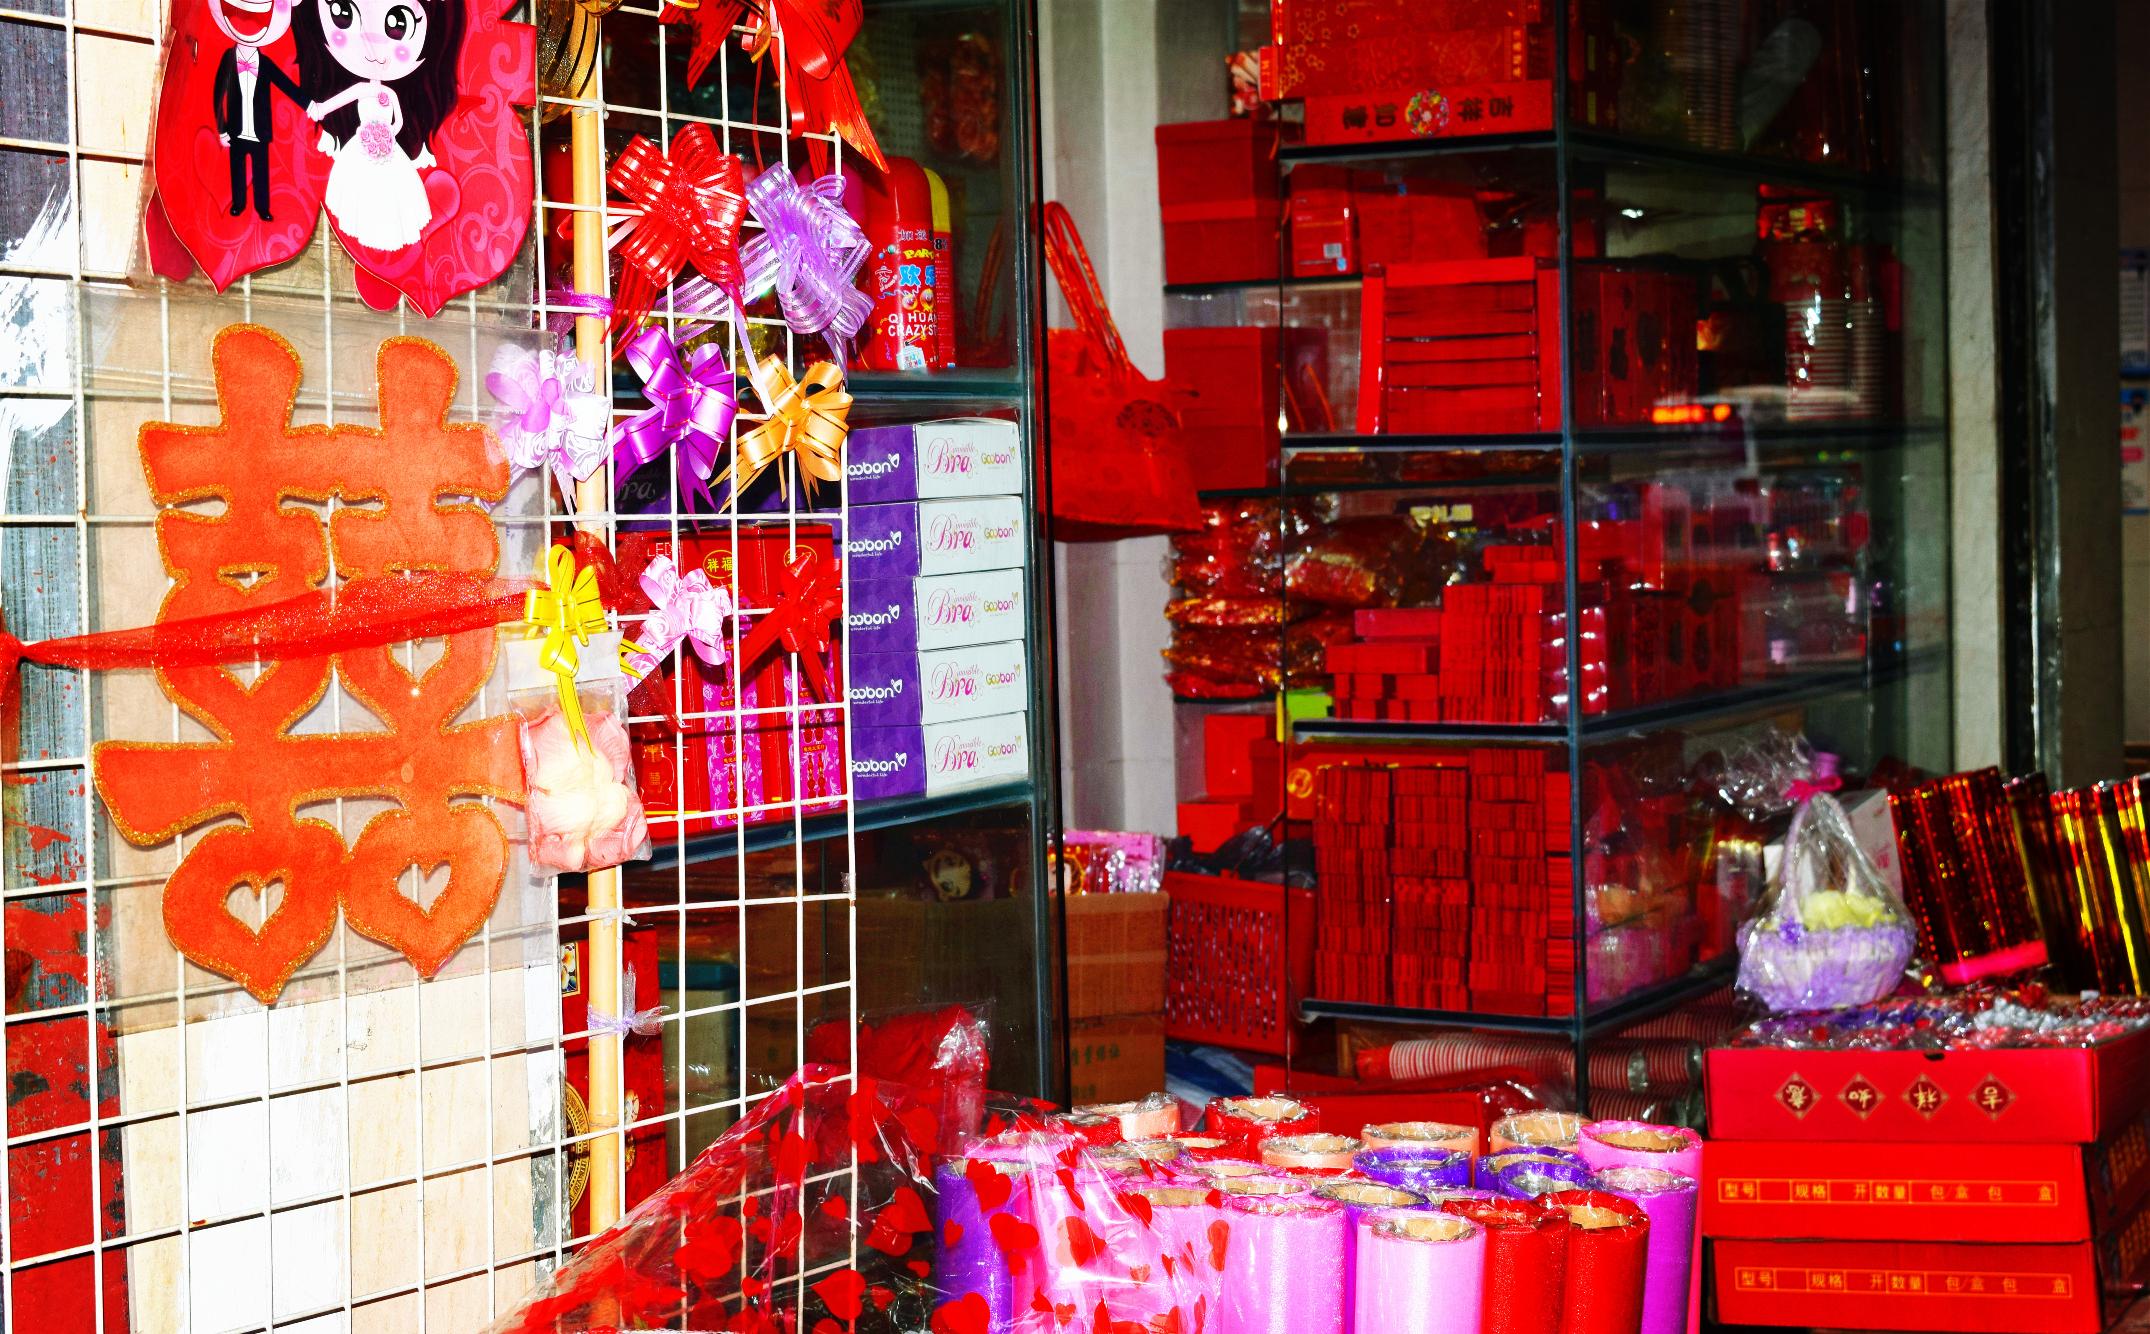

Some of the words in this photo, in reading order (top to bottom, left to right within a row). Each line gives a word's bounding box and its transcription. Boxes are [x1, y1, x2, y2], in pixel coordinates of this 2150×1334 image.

[888, 324, 927, 337] CRAZY
[924, 438, 973, 476] Bra
[848, 461, 891, 476] oobon
[926, 513, 976, 552] Bra
[924, 588, 974, 626] Bra
[849, 612, 891, 626] oobon
[928, 662, 977, 701] Bra
[850, 686, 895, 699] oobon
[932, 735, 979, 773] Bra
[1725, 1183, 1755, 1199] 型号
[1796, 1184, 1826, 1199] 规格
[1875, 1184, 1906, 1200] 数量
[1741, 1271, 1771, 1287] 型号
[1812, 1273, 1842, 1288] 规格
[1892, 1275, 1921, 1291] 数量
